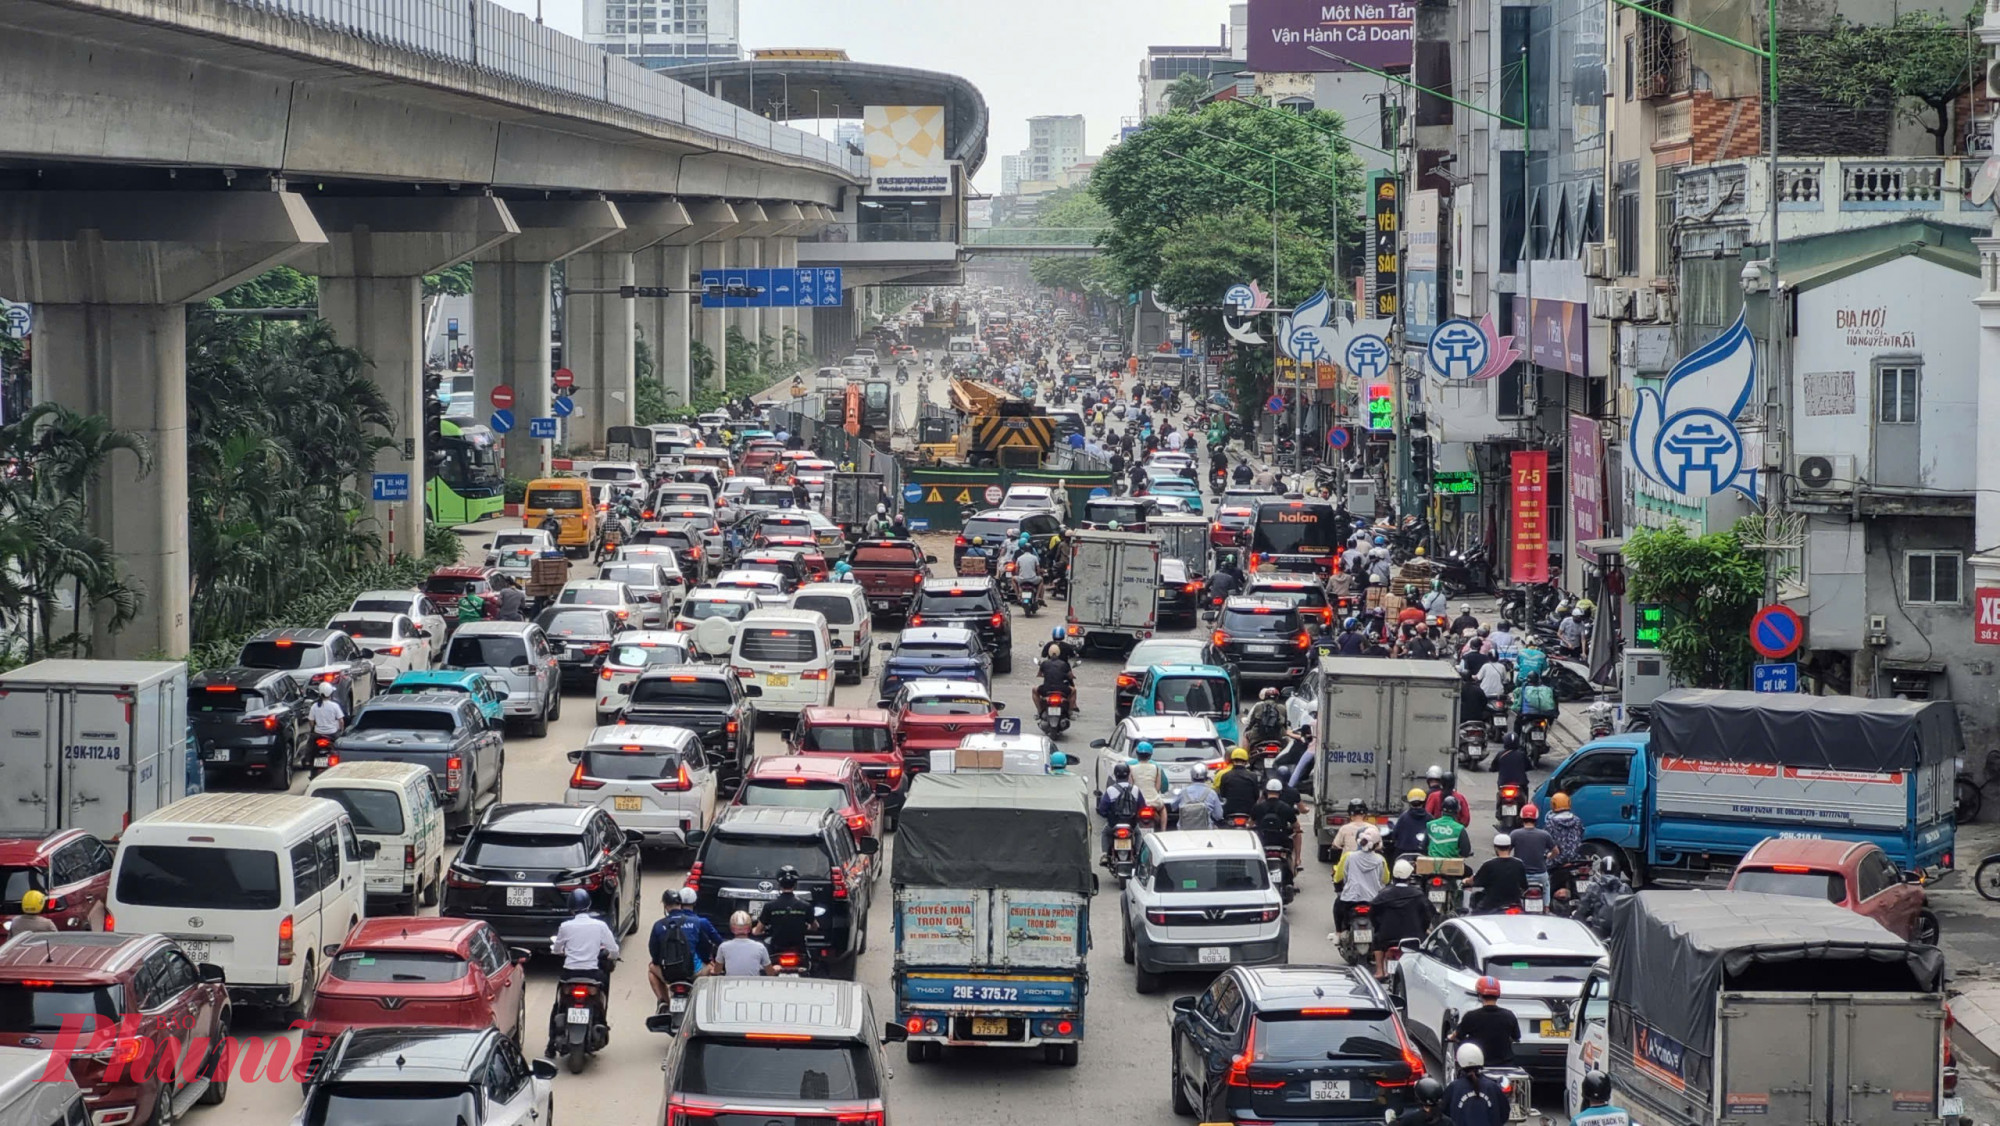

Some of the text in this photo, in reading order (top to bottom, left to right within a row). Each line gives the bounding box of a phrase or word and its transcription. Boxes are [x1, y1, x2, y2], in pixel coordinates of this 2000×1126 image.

[1322, 5, 1350, 22] Một
[1355, 4, 1384, 19] Nền
[1272, 28, 1300, 45] Vận
[1304, 27, 1342, 42] Hành
[1346, 26, 1366, 41] Cả
[1378, 207, 1397, 231] YẾN
[1378, 252, 1398, 272] SÀO
[1836, 309, 1857, 329] BIA
[1518, 469, 1541, 484] 7-5
[1278, 512, 1318, 523] halan
[1319, 647, 1331, 656] be
[1000, 719, 1014, 733] G7
[65, 746, 120, 760] 29K-112.48
[1328, 751, 1374, 764] 29H-024.93
[1430, 823, 1453, 835] Grab
[908, 903, 971, 915] CHUYỂN NHÀ
[187, 941, 203, 951] 29D
[976, 1025, 1004, 1035] 375.72
[1321, 1081, 1338, 1090] 30K
[1314, 1090, 1346, 1099] 904.24
